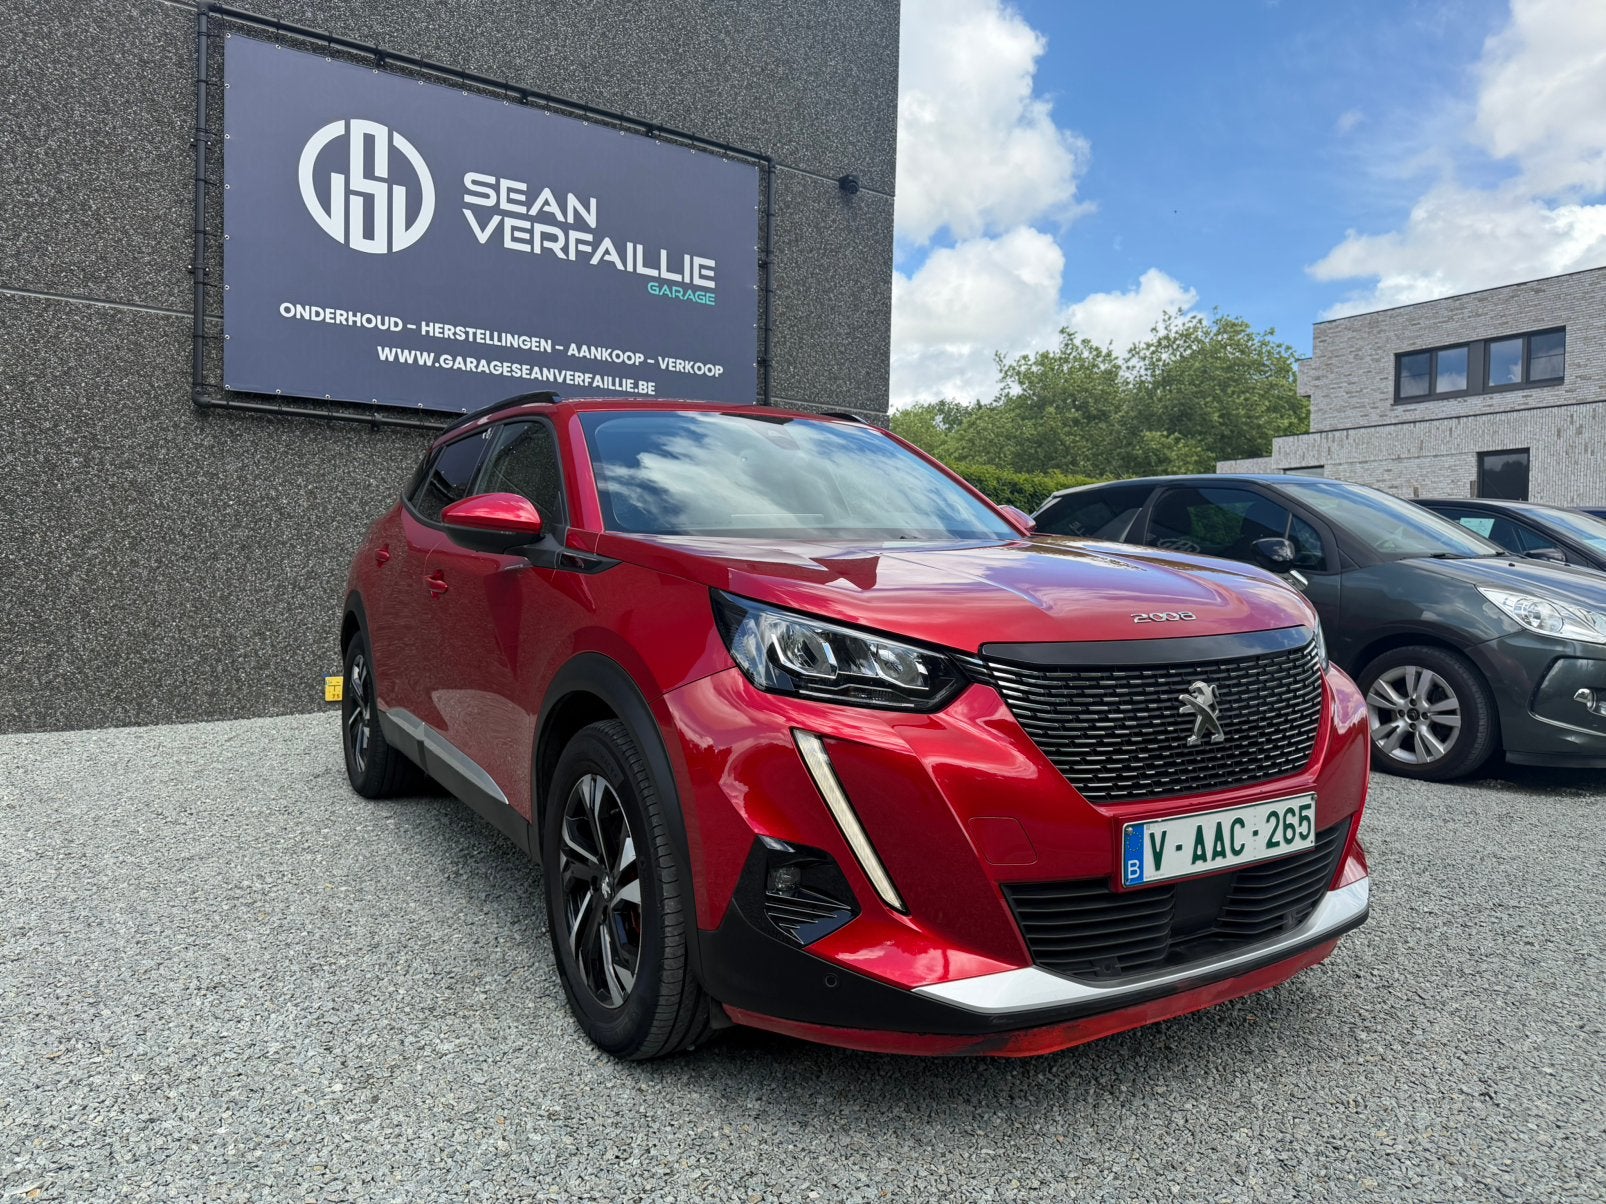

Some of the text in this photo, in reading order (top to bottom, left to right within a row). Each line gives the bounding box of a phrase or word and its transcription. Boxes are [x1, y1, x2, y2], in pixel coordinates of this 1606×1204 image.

[463, 171, 597, 229] SEAN
[462, 208, 716, 288] VERFAILLIE
[647, 282, 716, 306] GARAGE
[279, 302, 403, 332] ONDERHOUD
[421, 321, 552, 352] HERSTELLINGEN
[567, 343, 645, 366] AANKOOP
[658, 356, 724, 378] VERKOOP
[377, 346, 656, 395] WWW.GARAGESEANVERFAILLIE.BE
[1130, 611, 1198, 624] 2008
[1127, 803, 1312, 879] B V-AAC-265
